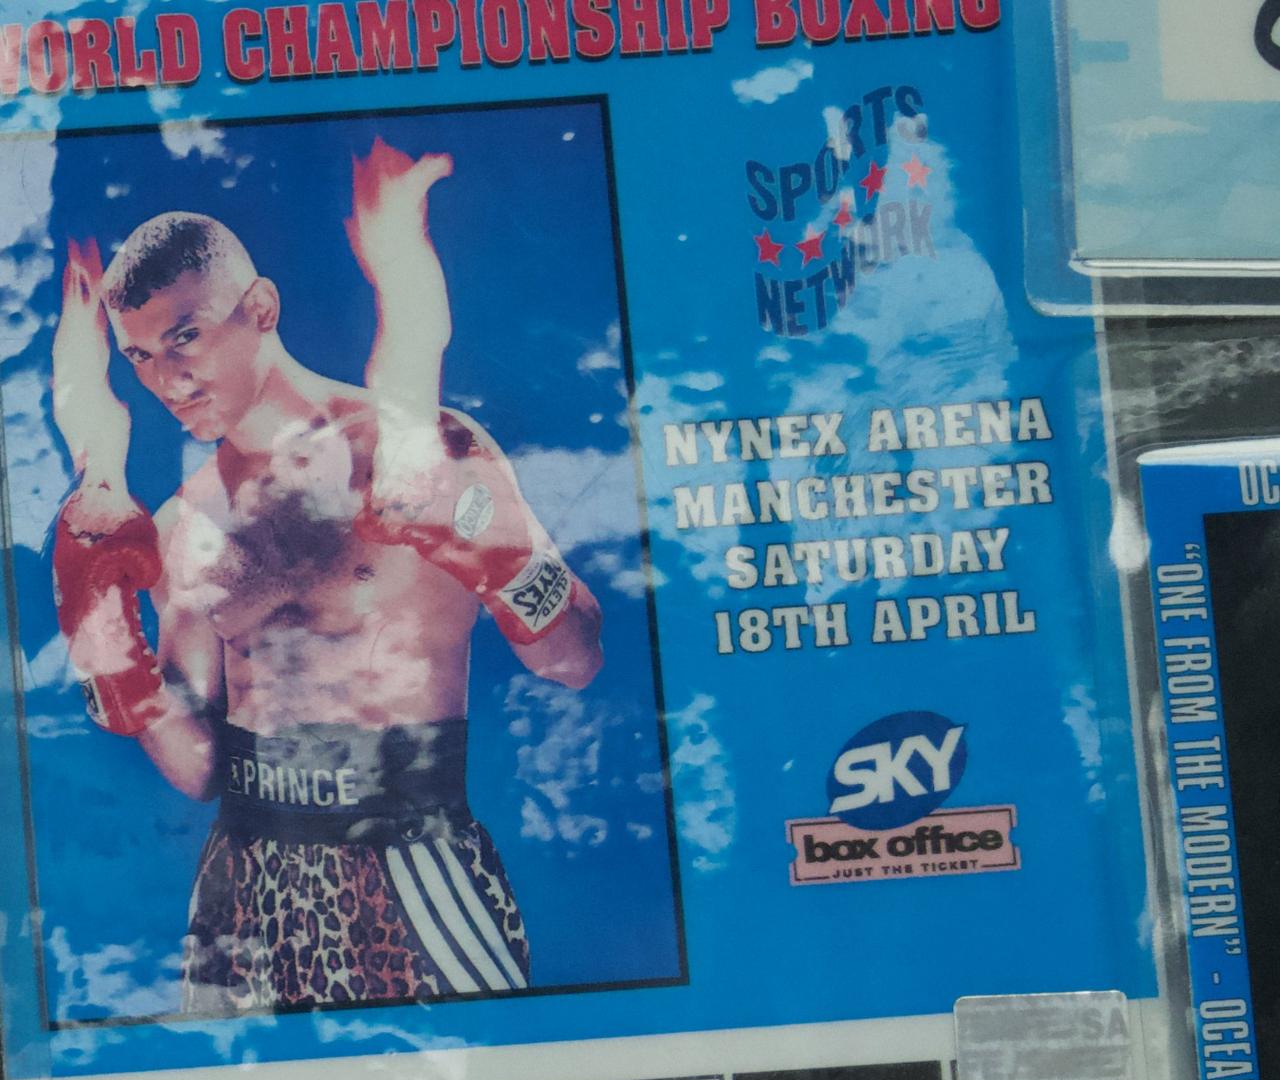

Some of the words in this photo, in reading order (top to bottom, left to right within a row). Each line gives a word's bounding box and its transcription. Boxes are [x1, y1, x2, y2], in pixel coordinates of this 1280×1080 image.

[223, 0, 729, 81] CHAMPIONSHIP
[745, 86, 928, 222] SPORTS
[754, 201, 934, 337] NETWORK
[663, 412, 847, 466] NYNEX
[868, 396, 1054, 454] ARENA
[672, 461, 1054, 530] MANCHESTER
[725, 527, 1011, 590] SATURDAY
[714, 603, 850, 655] 18TH
[871, 590, 1037, 644] APRIL
[1164, 636, 1218, 725] FROM
[243, 757, 360, 807] PRINCE
[829, 725, 966, 814] SKY
[1173, 735, 1225, 792] THE
[803, 834, 881, 863] box
[886, 825, 1003, 857] office
[832, 866, 873, 880] JUST
[882, 864, 913, 876] THE
[921, 860, 979, 873] TICKET
